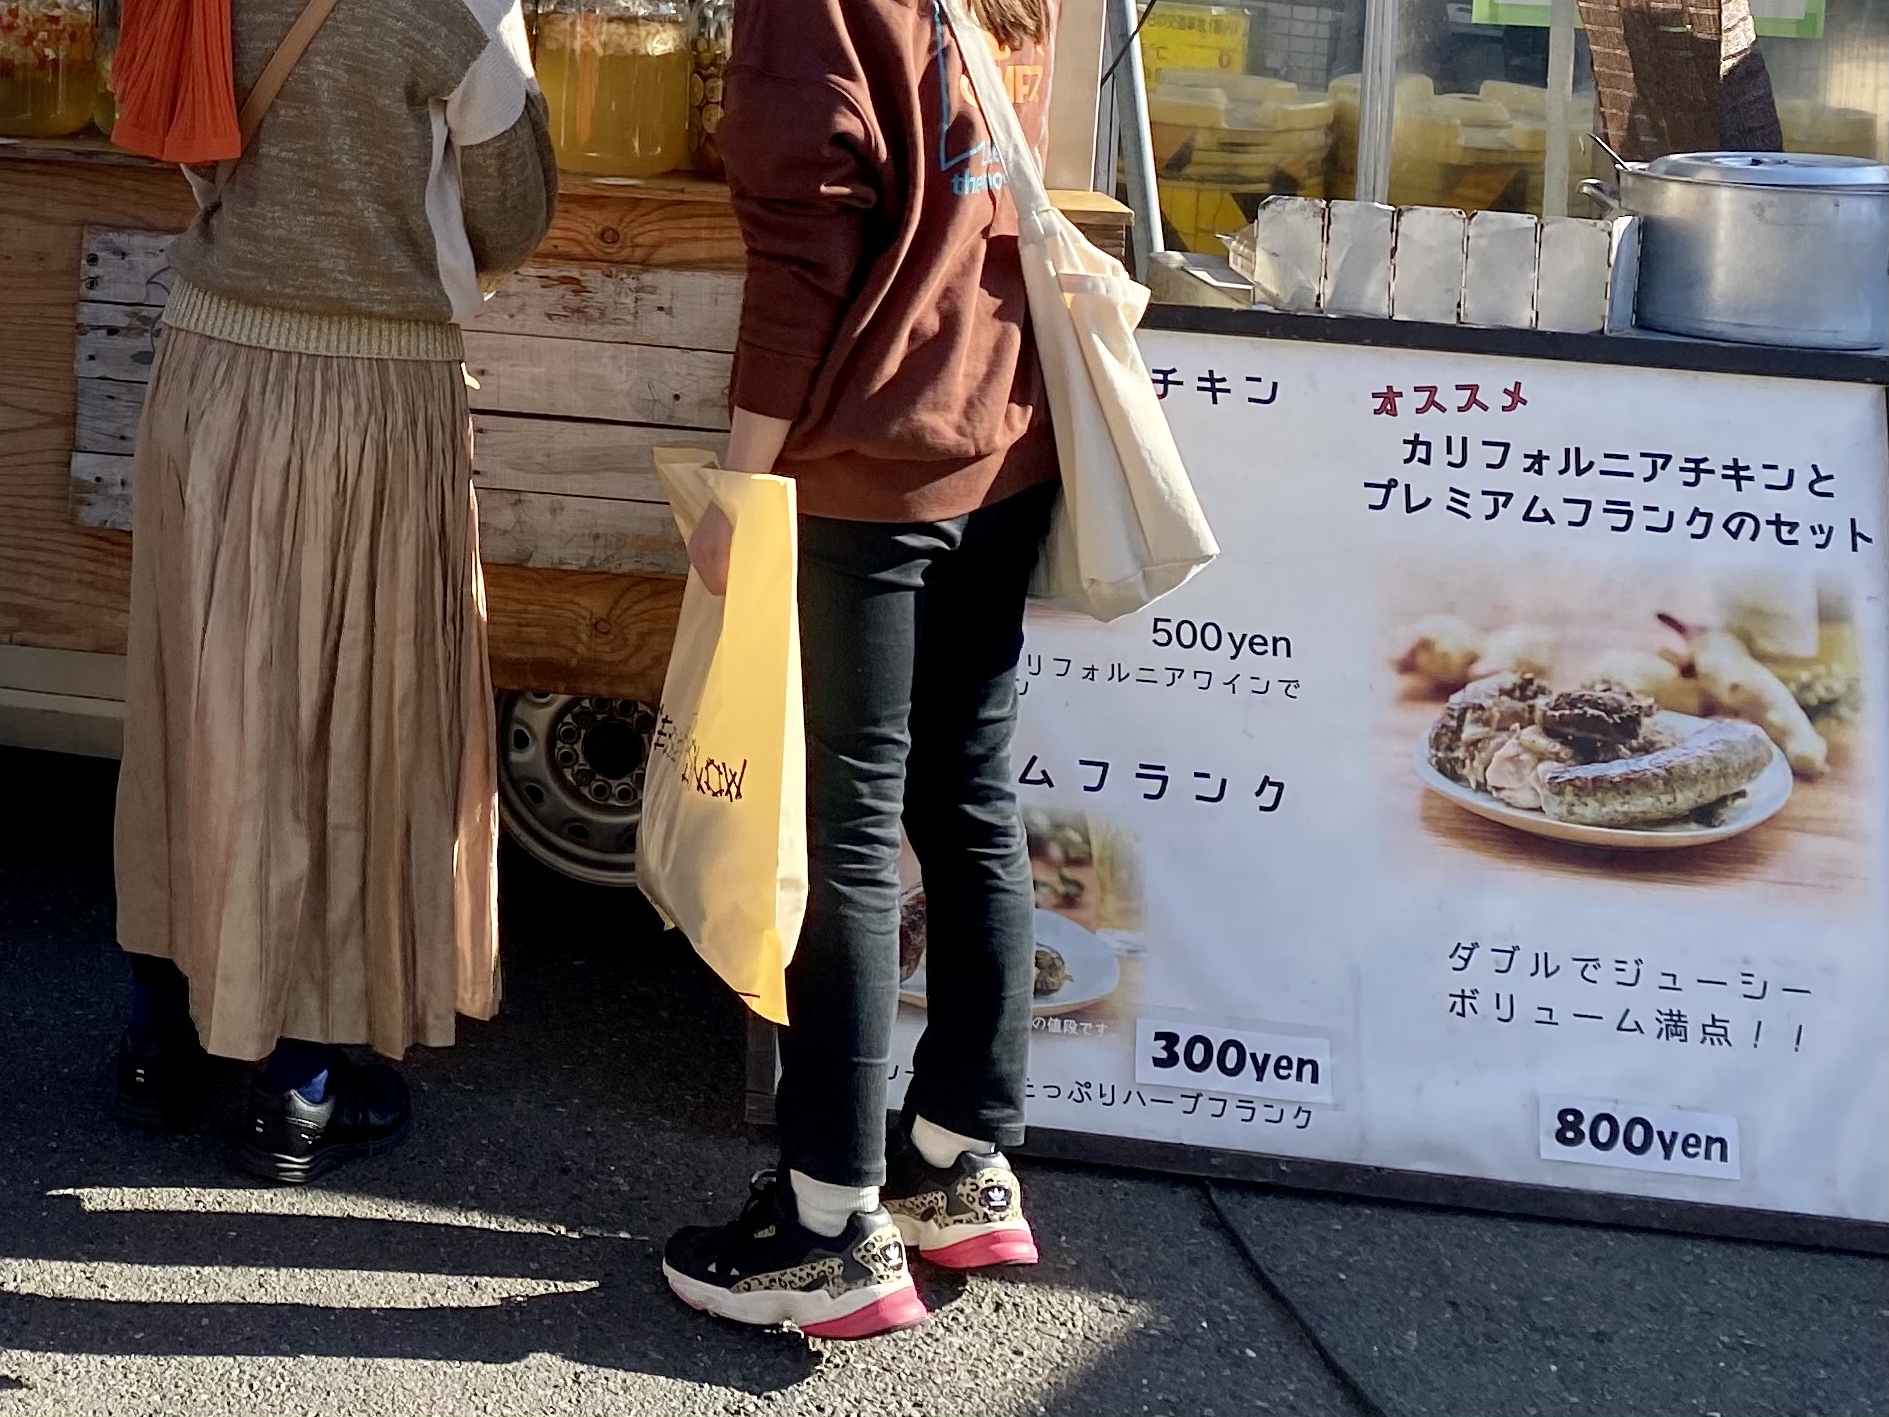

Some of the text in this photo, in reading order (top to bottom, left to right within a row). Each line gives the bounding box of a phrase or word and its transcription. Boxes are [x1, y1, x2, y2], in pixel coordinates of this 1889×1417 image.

[1151, 366, 1279, 405] チキン
[1371, 380, 1529, 418] オススメ
[1402, 432, 1836, 500] カリフォルニアチキンと
[1363, 477, 1874, 553] プレミアムフランクのセット
[1151, 616, 1292, 661] 500yen
[1018, 754, 1286, 813] ムフランク
[1448, 941, 1812, 1000] ダブルでジューシー
[1031, 1015, 1109, 1038] の値段です
[1150, 1030, 1320, 1085] 300yen
[1554, 1107, 1730, 1164] 800yen
